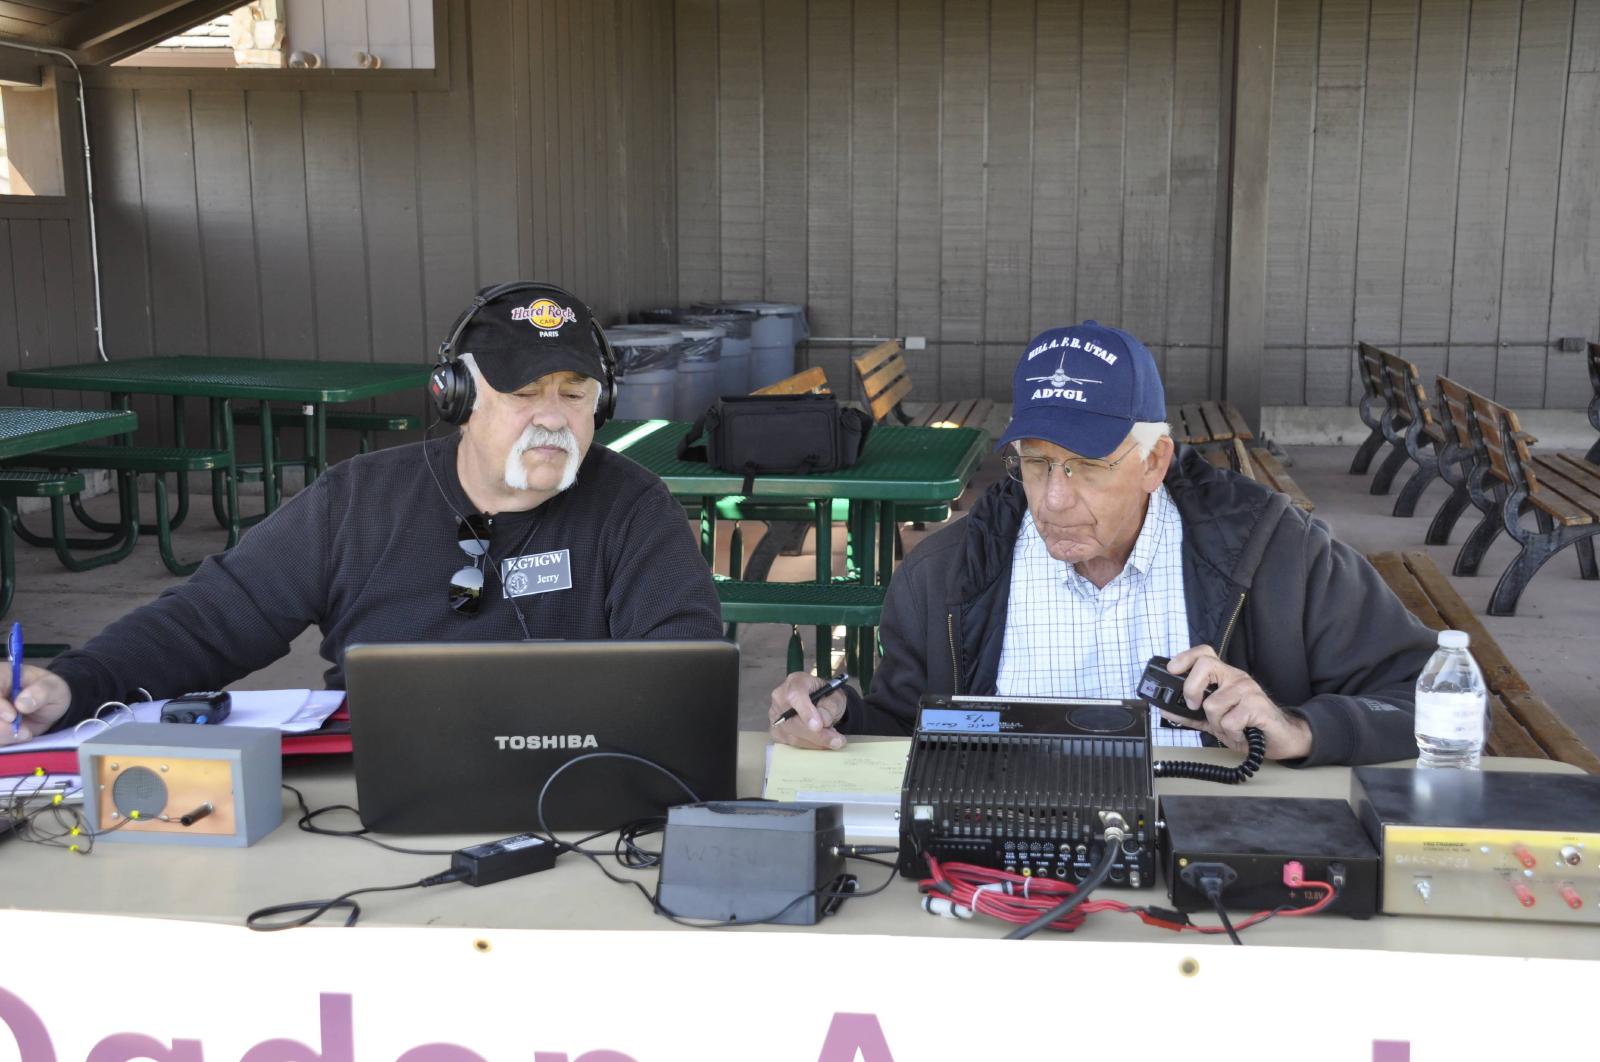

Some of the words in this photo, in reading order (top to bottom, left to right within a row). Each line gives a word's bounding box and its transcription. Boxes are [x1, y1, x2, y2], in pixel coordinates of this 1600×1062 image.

[511, 305, 544, 320] Hard
[547, 305, 577, 322] Rock
[539, 330, 559, 338] PARIS
[1083, 341, 1118, 366] UTAH
[508, 552, 563, 571] KG7IGW
[537, 573, 560, 584] Jerry
[494, 734, 599, 750] TOSHIBA
